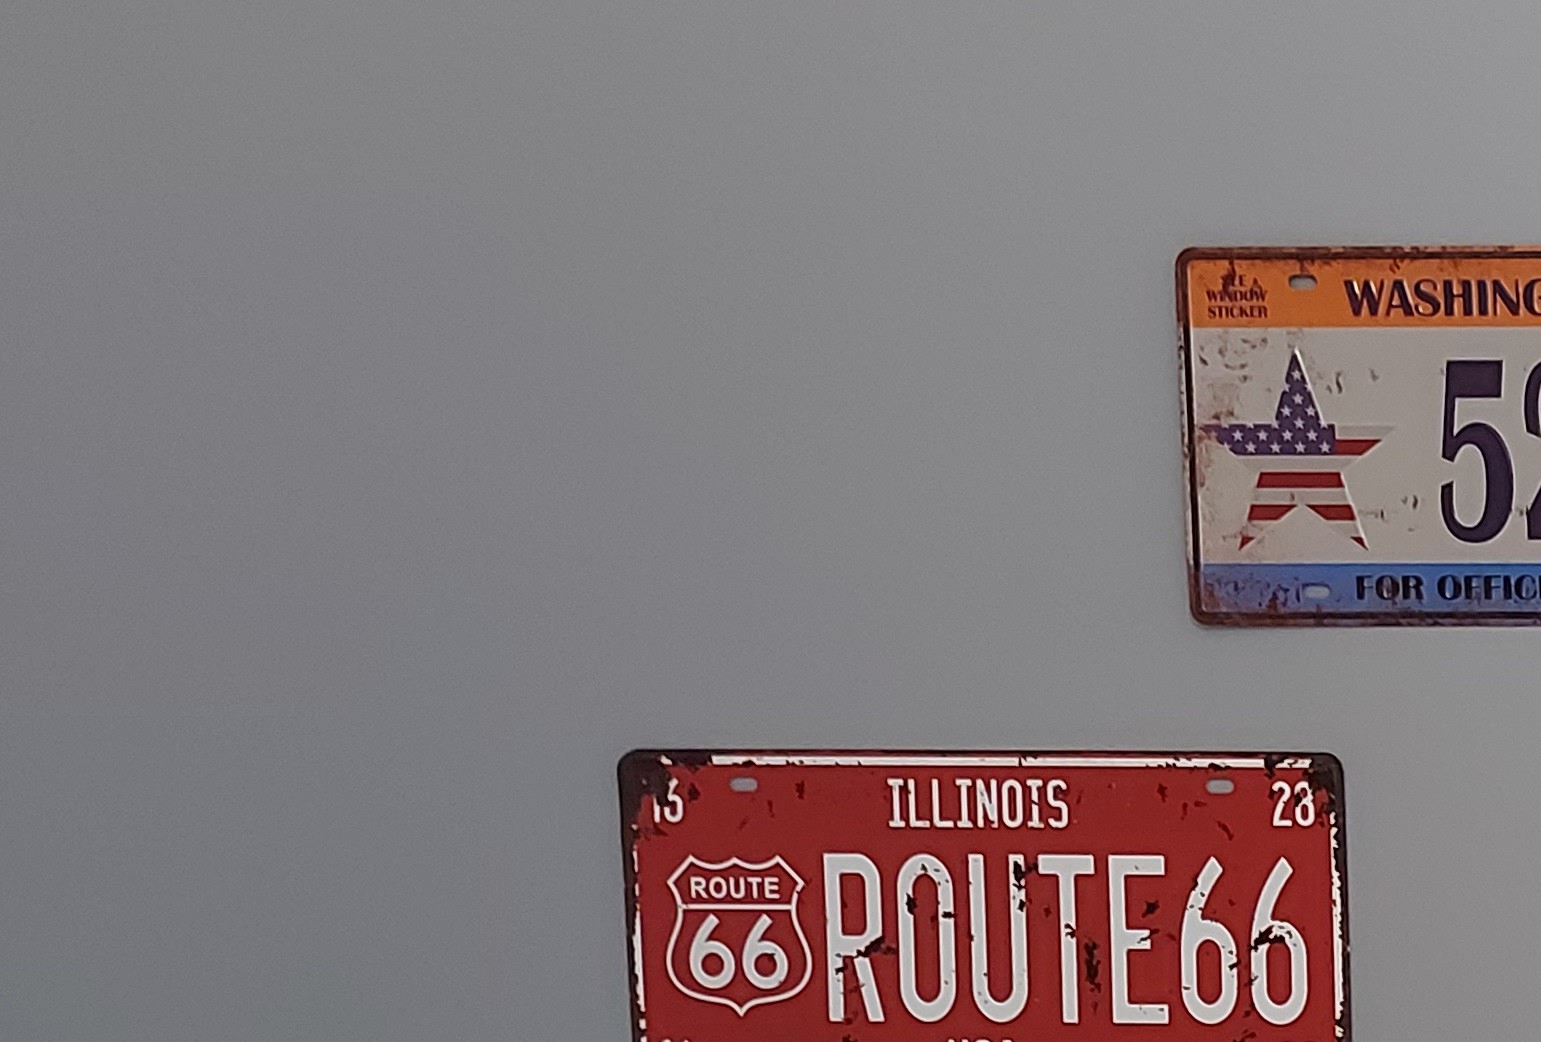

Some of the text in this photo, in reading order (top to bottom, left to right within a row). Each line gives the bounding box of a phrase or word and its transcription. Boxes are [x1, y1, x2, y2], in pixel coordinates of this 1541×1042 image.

[1206, 289, 1268, 302] WINDOW
[1208, 305, 1268, 319] STICKER
[1355, 573, 1424, 601] FOR
[887, 777, 1069, 829] ILLINOIS
[1272, 780, 1315, 827] 28
[689, 876, 780, 900] ROUTE
[689, 912, 789, 990] 66
[822, 852, 1308, 1026] ROUTE66
